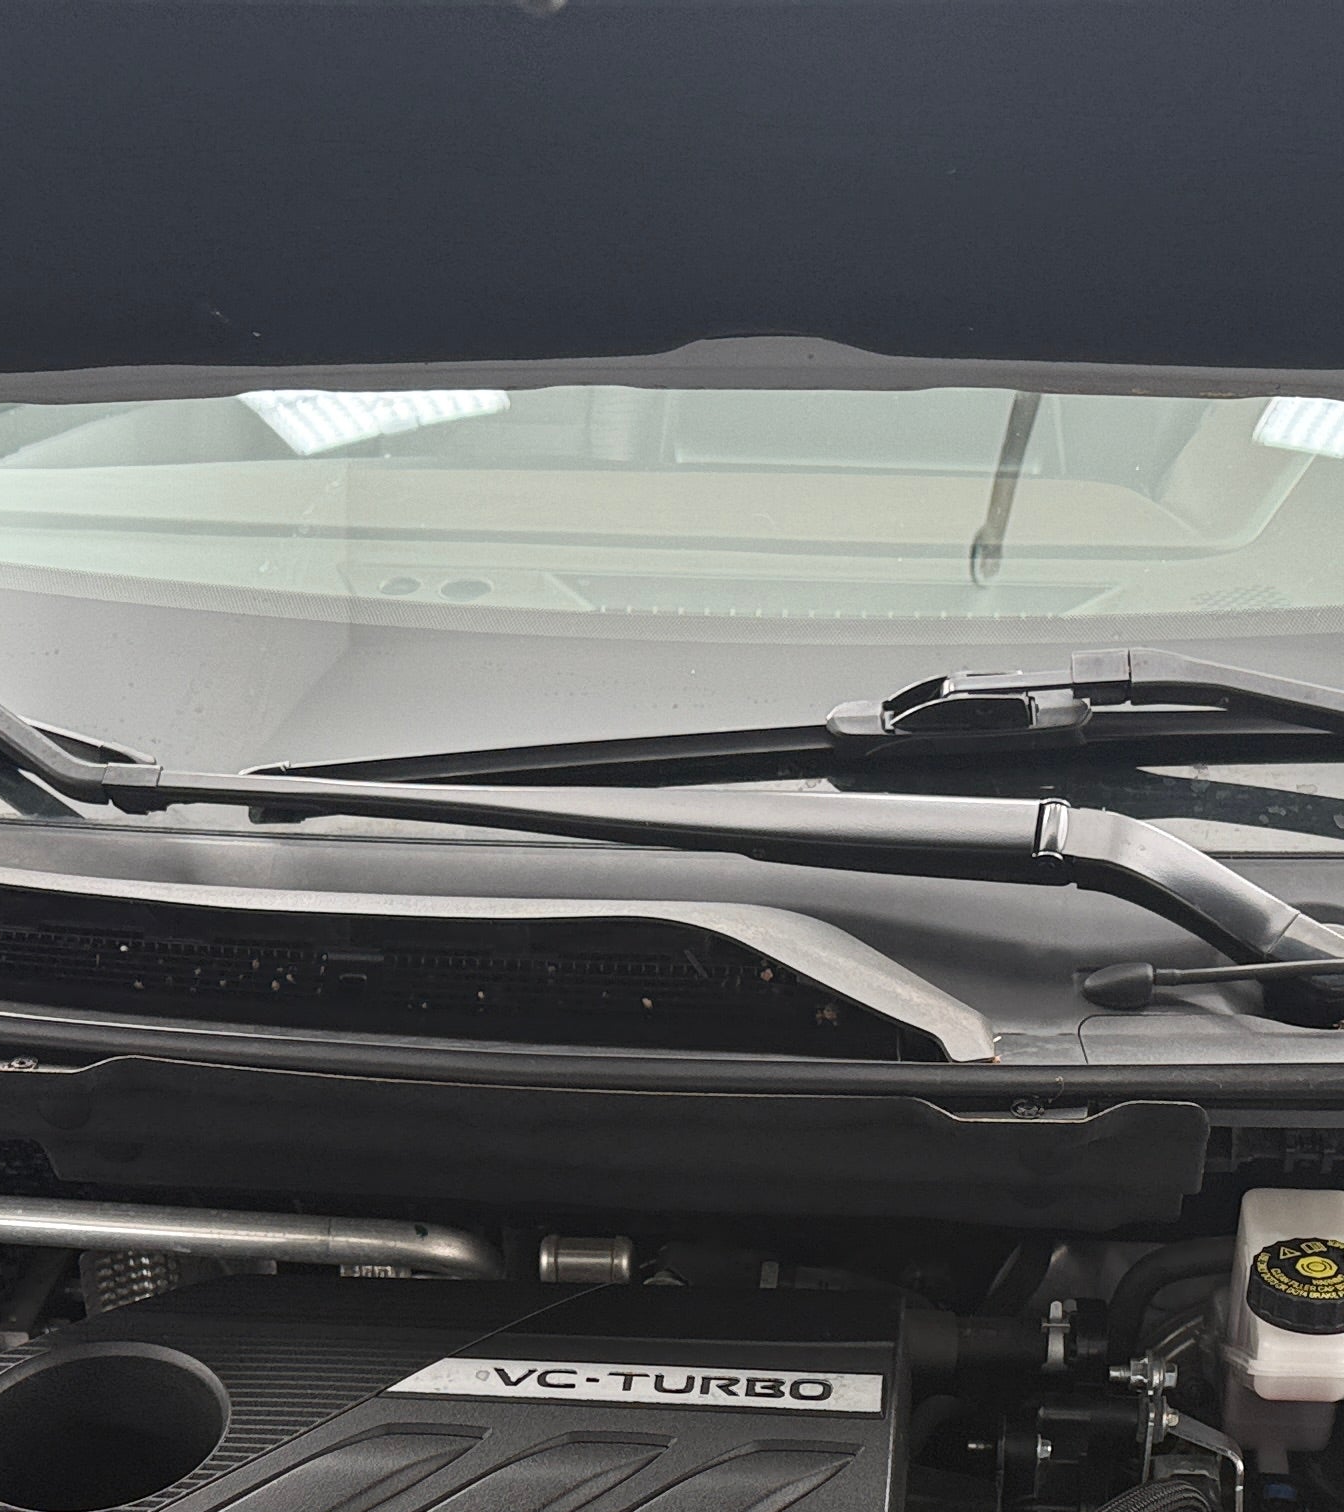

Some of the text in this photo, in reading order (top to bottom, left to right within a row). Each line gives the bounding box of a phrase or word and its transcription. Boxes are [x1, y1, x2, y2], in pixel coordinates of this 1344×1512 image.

[1290, 1280, 1316, 1292] FILLER
[1309, 1291, 1339, 1299] BRAKE
[494, 1366, 835, 1402] VC-TURBO
